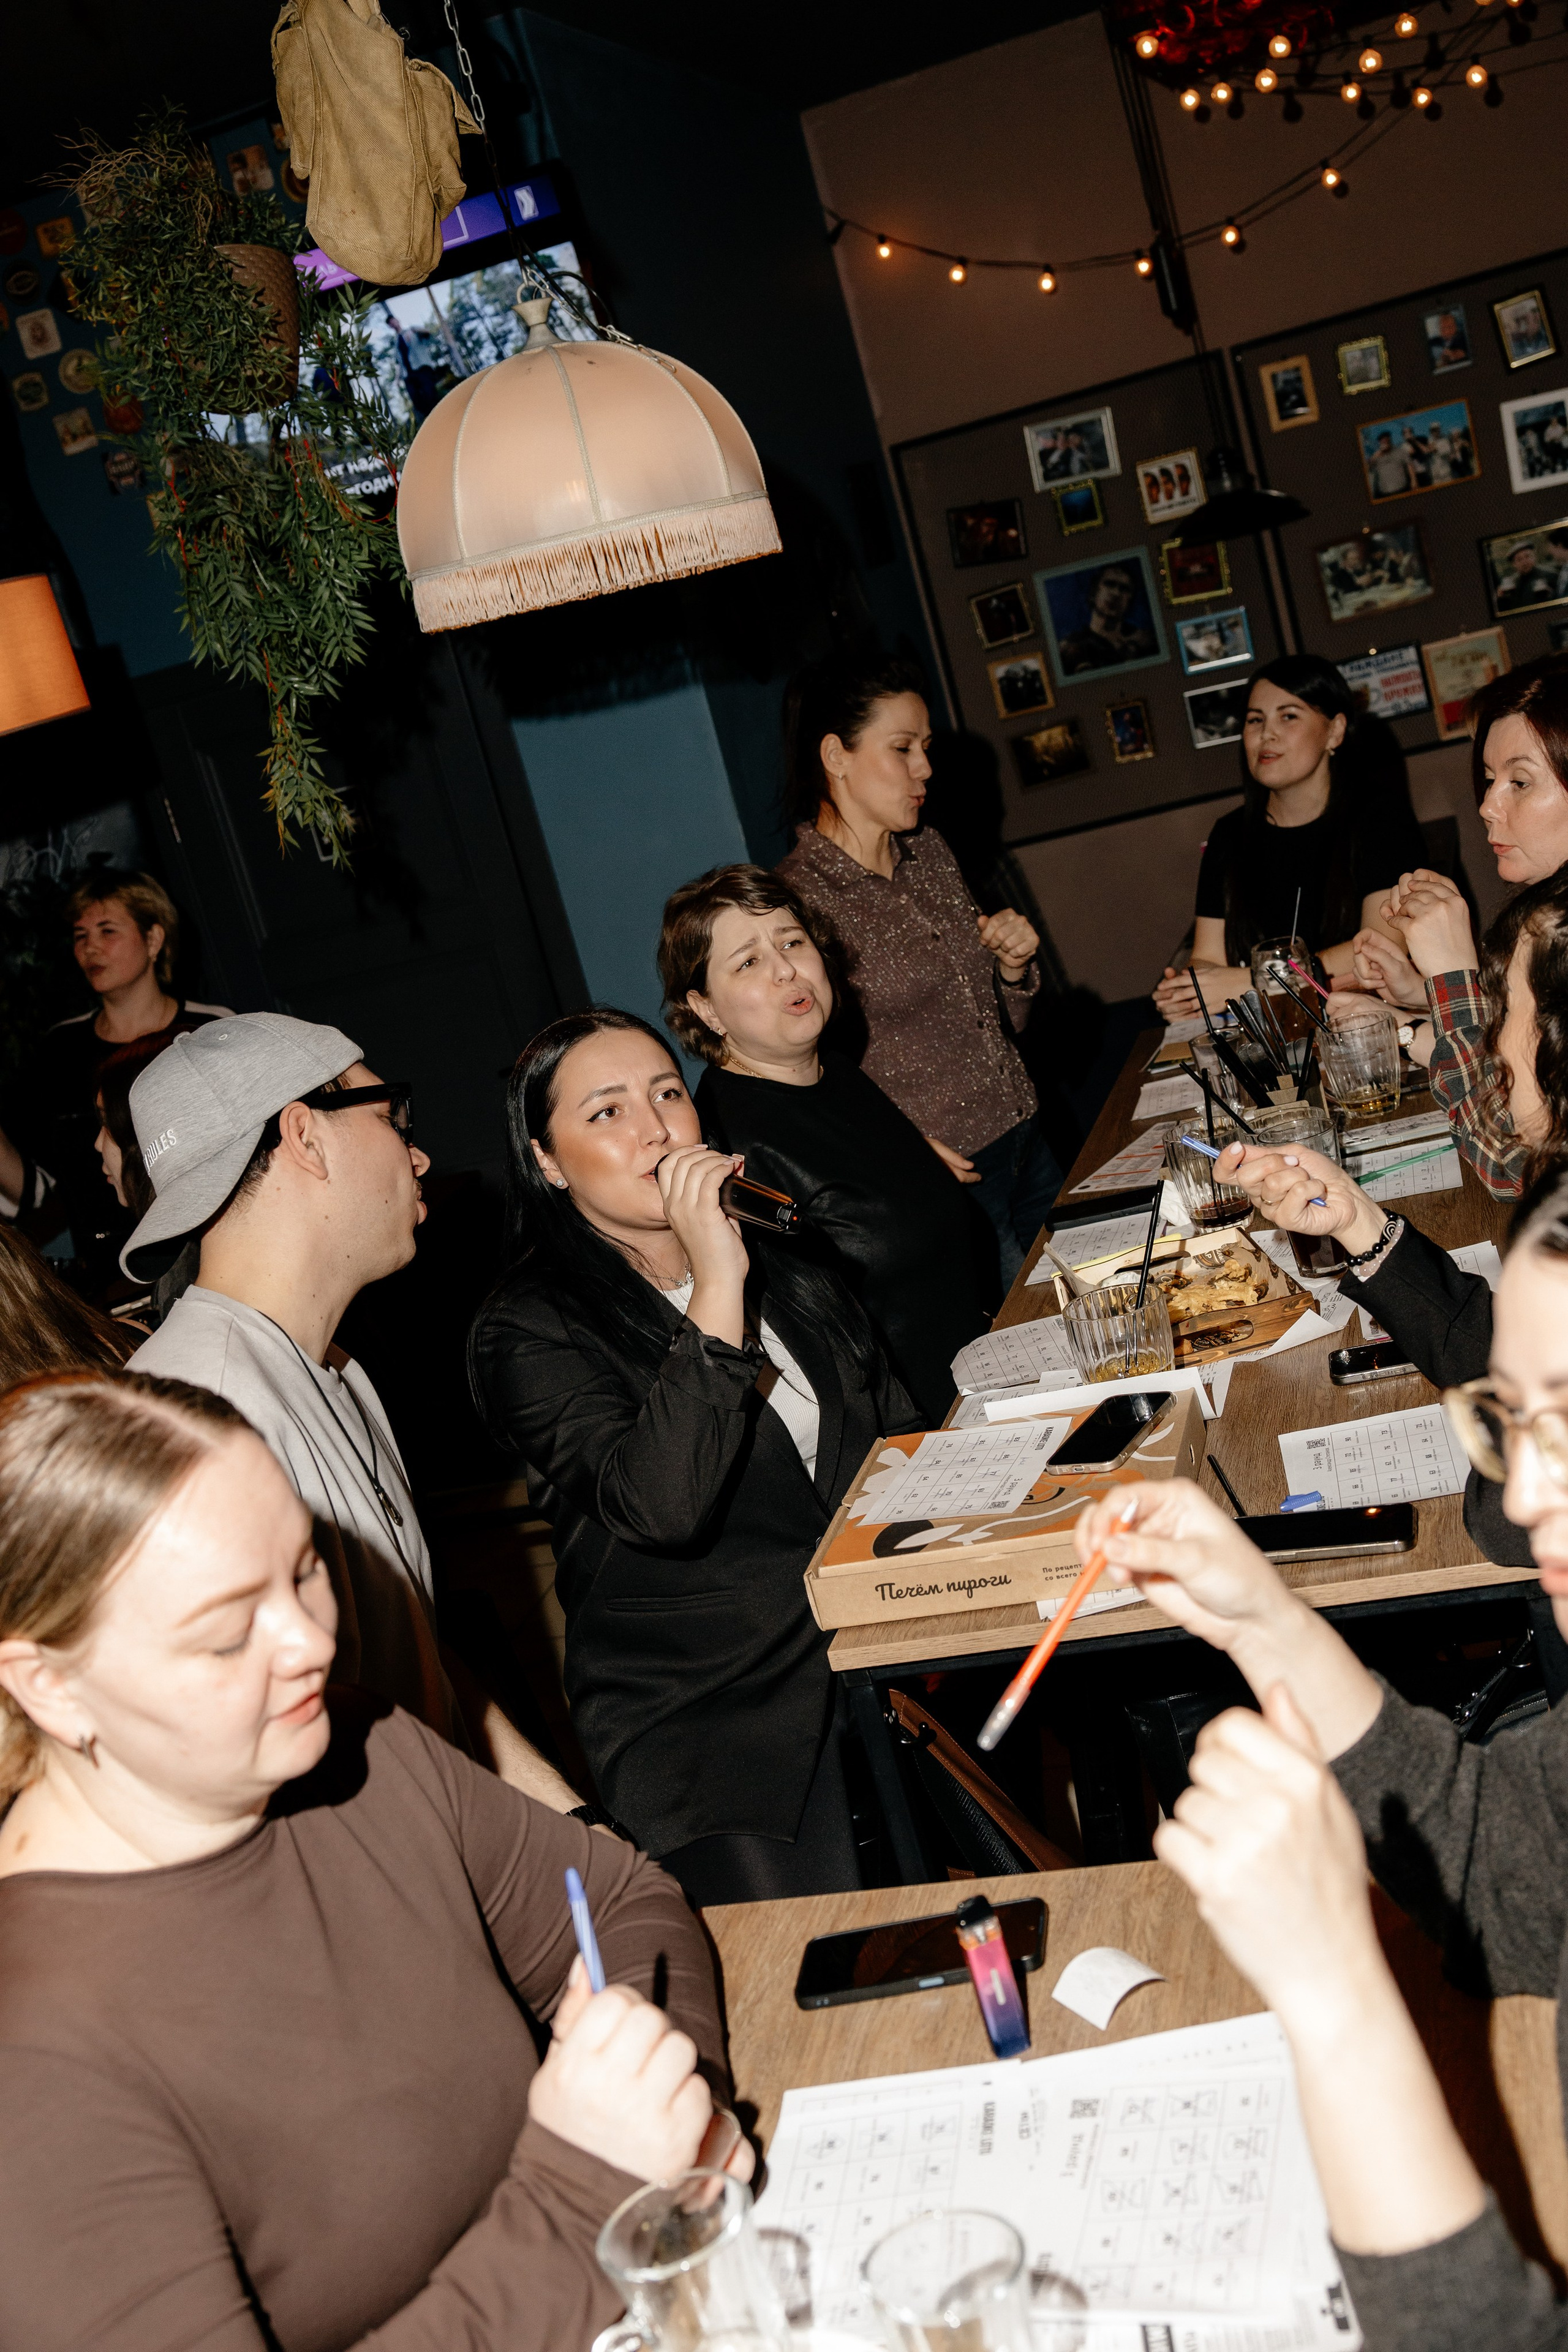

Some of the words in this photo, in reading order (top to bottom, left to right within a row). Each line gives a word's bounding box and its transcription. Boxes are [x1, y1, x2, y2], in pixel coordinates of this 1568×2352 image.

[1041, 1427, 1054, 1442] KARAOKE
[1313, 1452, 1324, 1466] раунд
[1002, 1481, 1018, 1496] раунд
[1055, 1563, 1082, 1572] рецепт
[875, 1582, 943, 1600] Печём
[946, 1573, 1012, 1599] пироги
